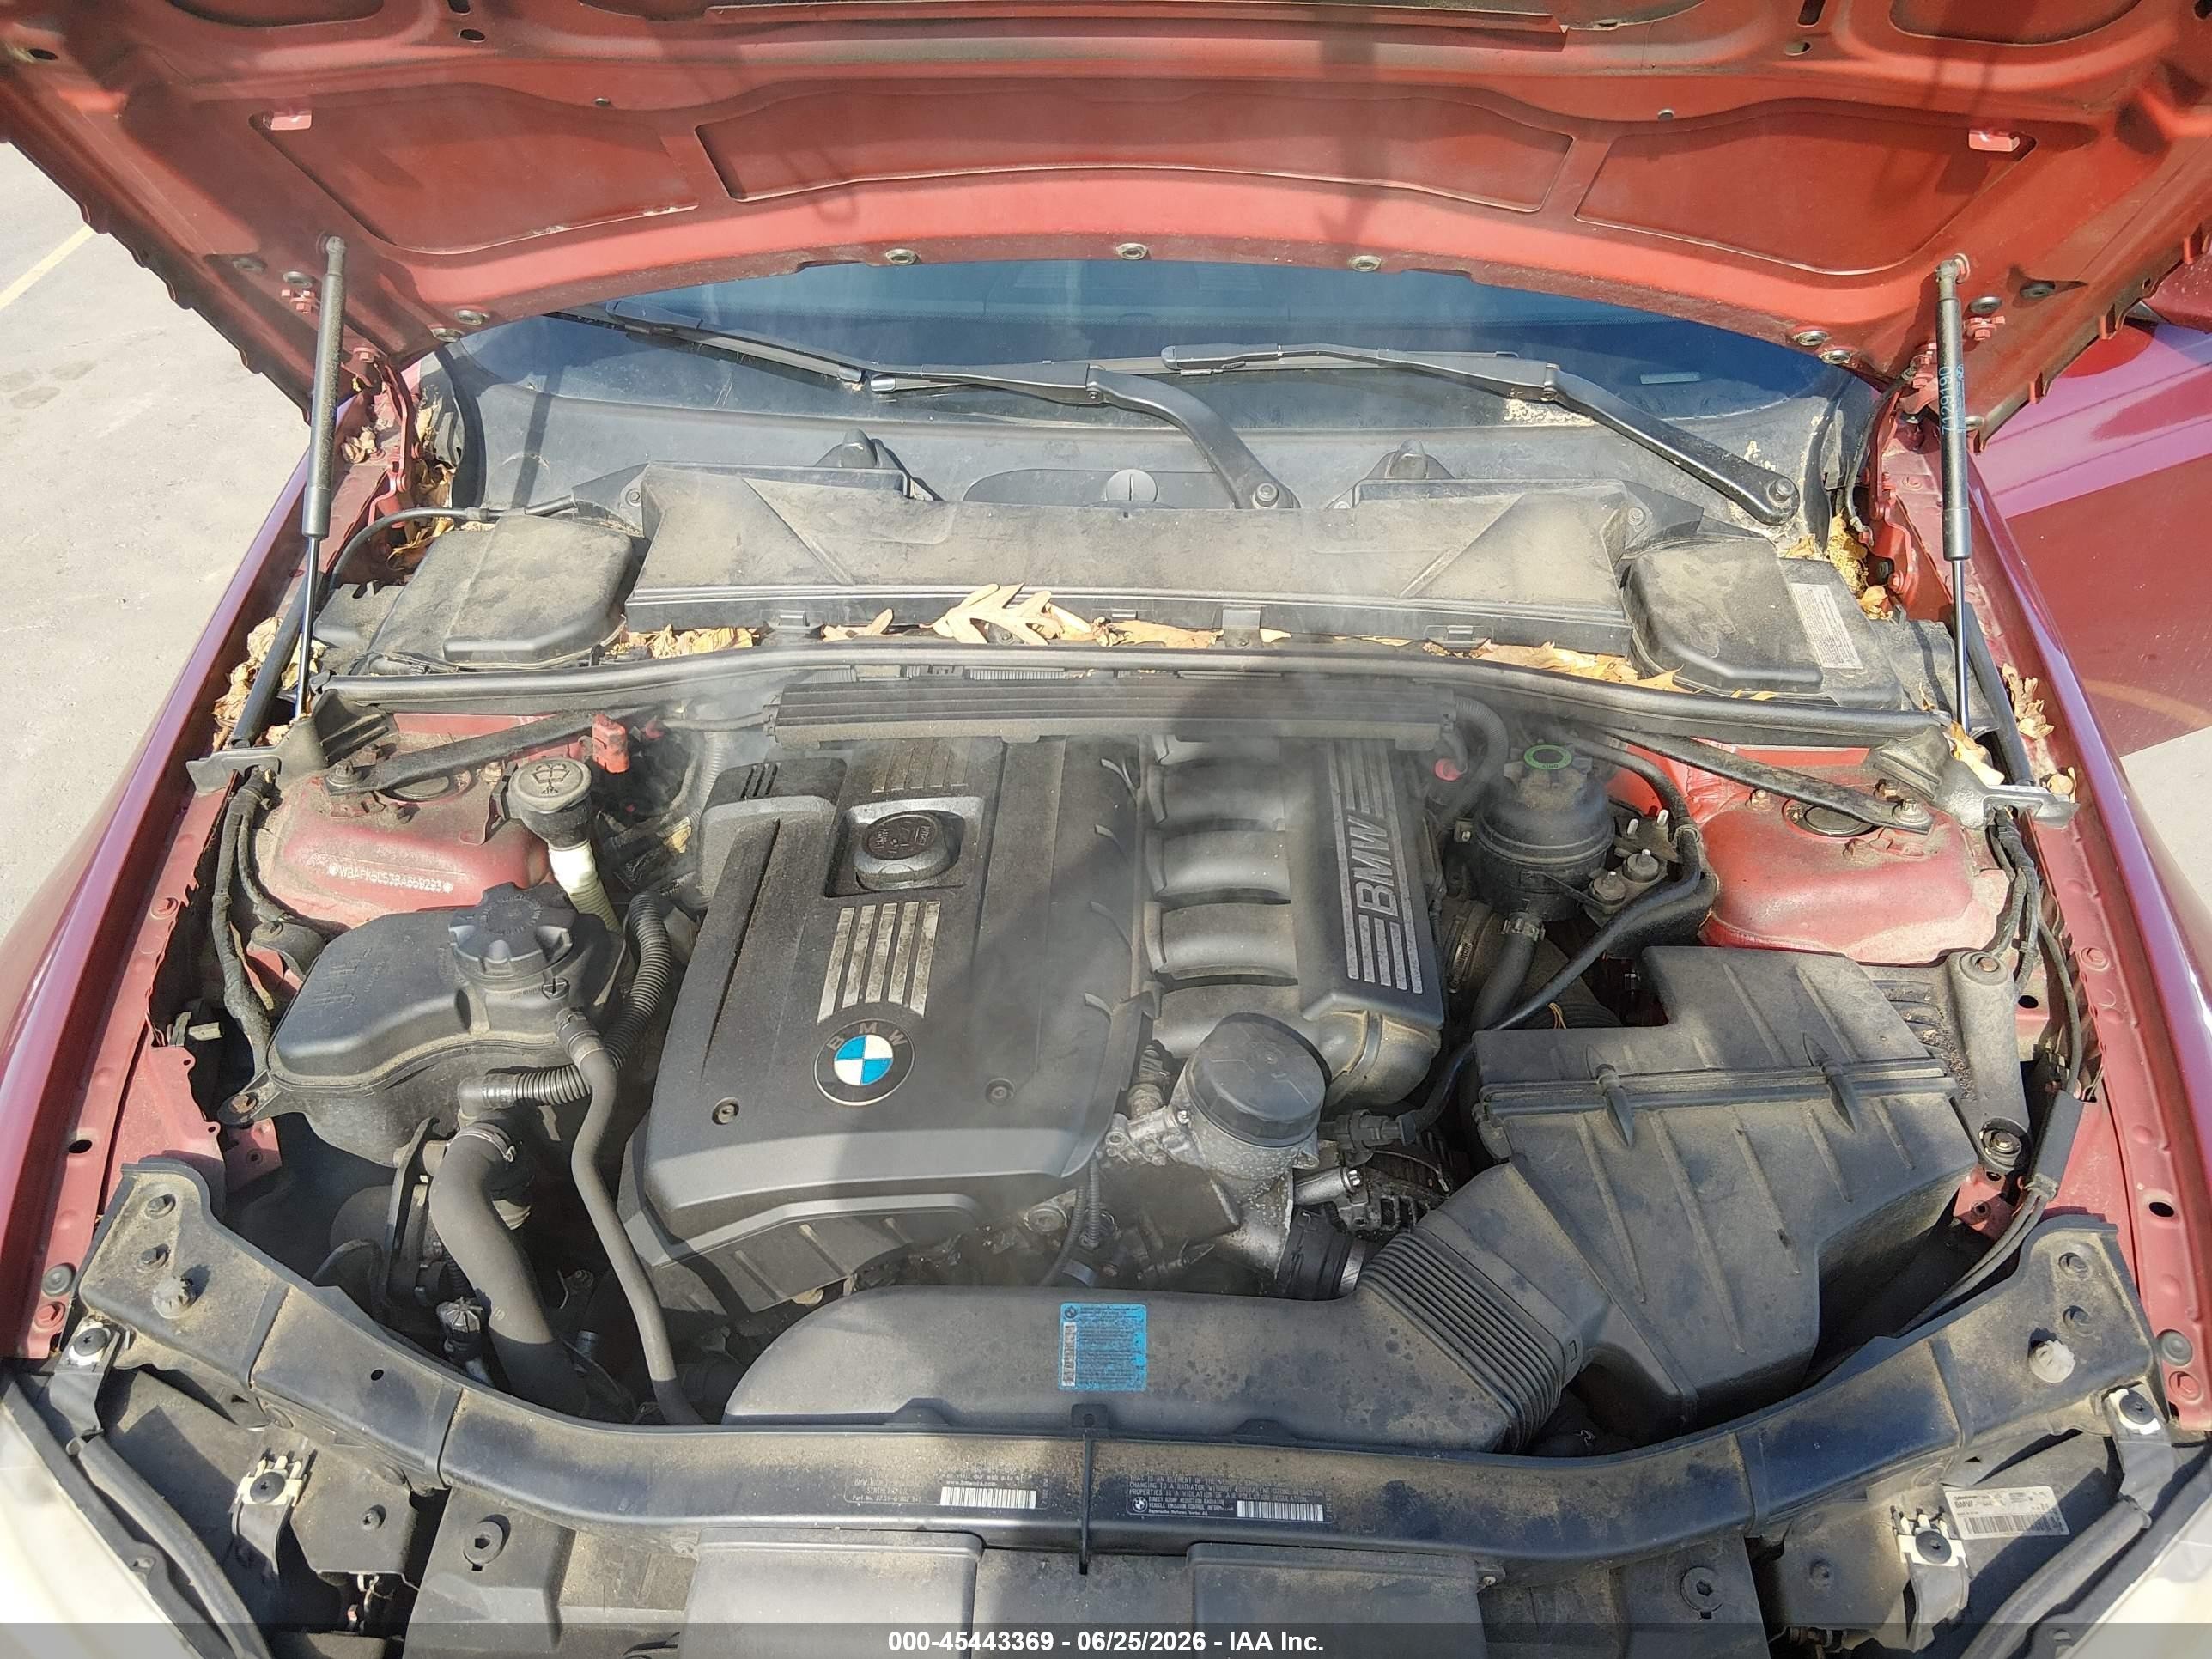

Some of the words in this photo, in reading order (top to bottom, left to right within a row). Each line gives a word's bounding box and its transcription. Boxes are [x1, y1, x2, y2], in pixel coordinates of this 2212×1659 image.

[1939, 366, 1955, 435] 7129190
[1347, 815, 1399, 917] BMW
[826, 1022, 908, 1051] BMW
